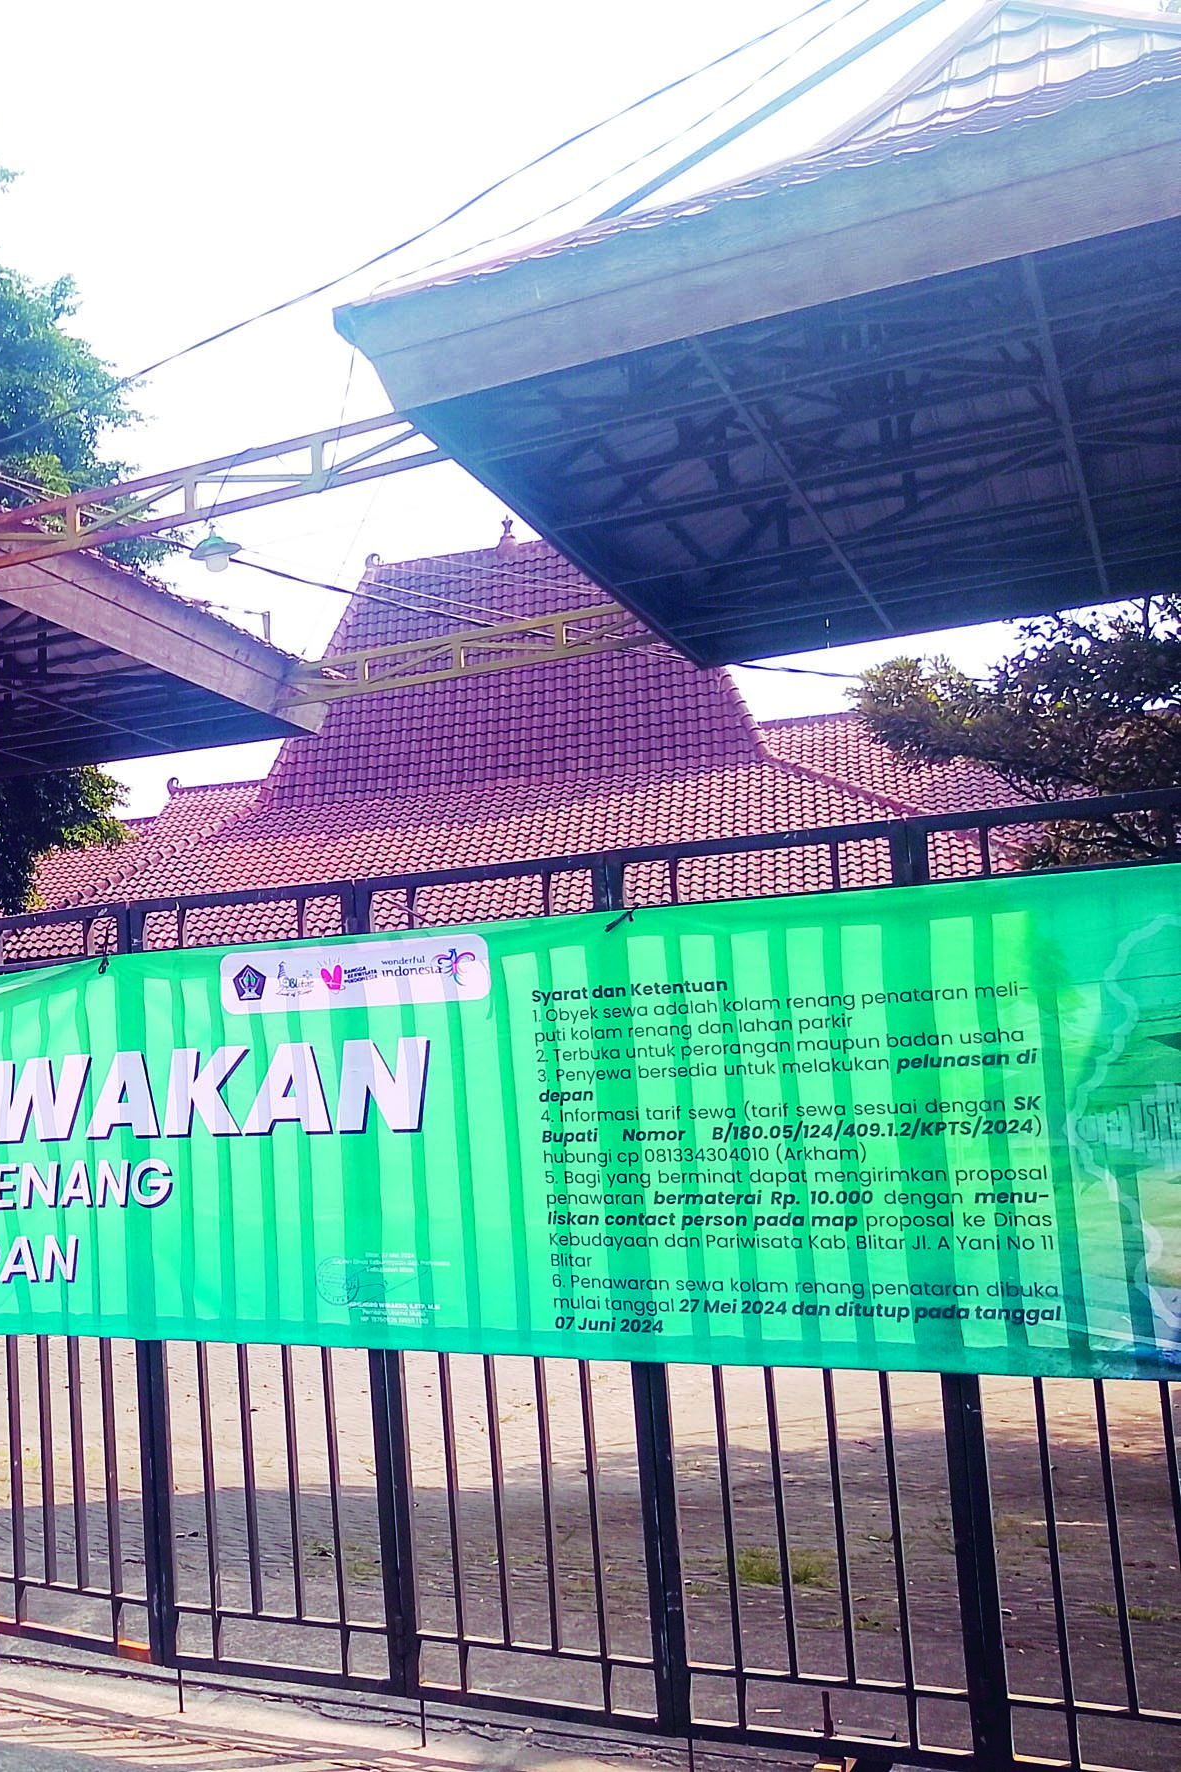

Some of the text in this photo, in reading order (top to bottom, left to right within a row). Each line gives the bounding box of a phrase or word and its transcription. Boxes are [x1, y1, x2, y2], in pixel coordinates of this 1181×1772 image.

[381, 955, 425, 965] wonderful
[382, 966, 442, 977] indonesia
[531, 978, 728, 1005] Syarat dan Ketentuan
[532, 982, 1029, 1026] 1. Obyek sewa adalah kolam renang penataran meli-
[534, 1014, 853, 1046] puti kolam renang dan lahan parkir
[536, 1028, 1025, 1063] 2. Terbuka untuk perorangan maupun badan usaha
[537, 1048, 1038, 1085] 3. Penyewa bersedia untuk melakukan pelunasan di
[538, 1088, 594, 1106] depan
[541, 1095, 1041, 1123] 4. Informasi tarif sewa (tarif sewa sesuai dengan SK
[541, 1114, 1042, 1146] Bupati Nomor B/180.05/124/409.1.2/KPTS/2024)
[543, 1142, 867, 1167] hubungi cp 081334304010 (Arkham)
[544, 1165, 1048, 1189] 5. Bagi yang berminat dapat mengirimkan proposal
[546, 1188, 1050, 1210] penawaran bermaterai Rp. 10.000 dengan menu-
[547, 1210, 1052, 1232] liskan contact person pada map proposal ke Dinas
[549, 1231, 1053, 1252] Kebudayaan dan Pariwisata Kab. Blitar Jl. A Yani No 11
[550, 1252, 592, 1268] Blitar
[551, 1274, 1059, 1300] 6. Penawaran sewa kolam renang penataran dibuka
[553, 1295, 1061, 1326] mulai tanggal 27 Mei 2024 dan ditutup pada tanggal
[554, 1315, 664, 1333] 07 Juni 2024
